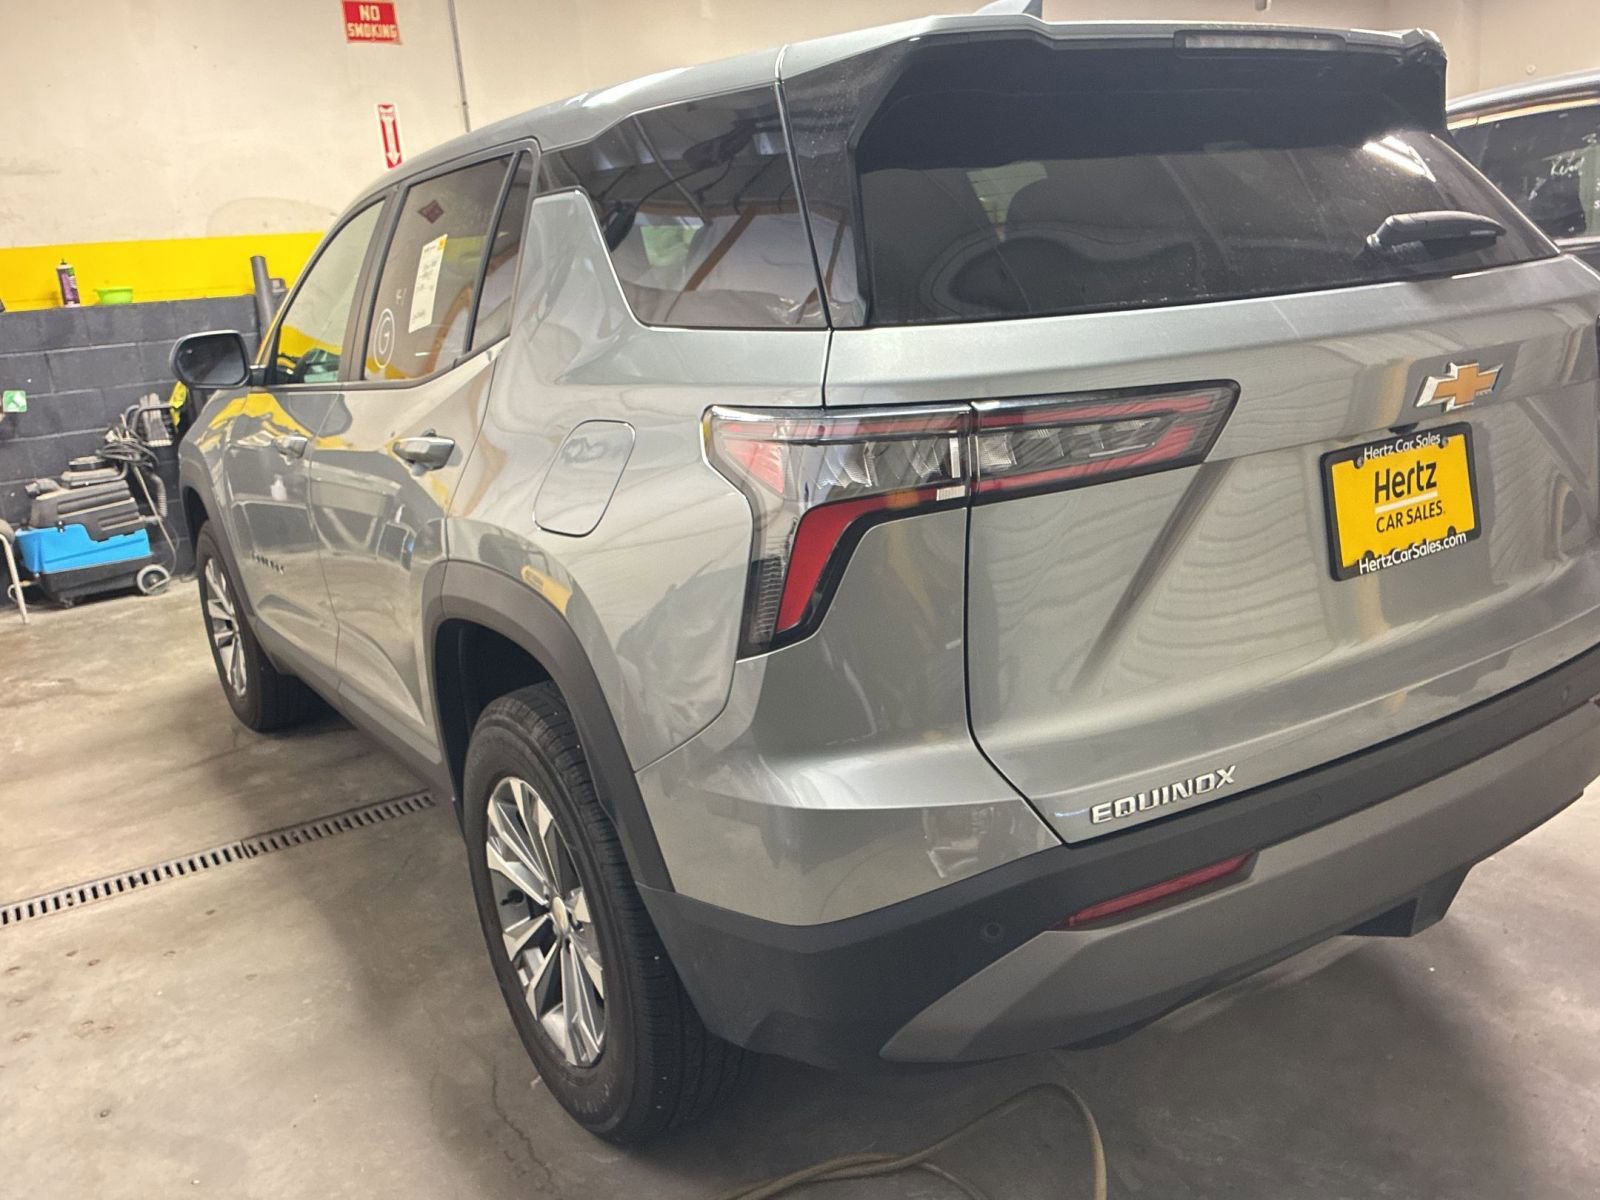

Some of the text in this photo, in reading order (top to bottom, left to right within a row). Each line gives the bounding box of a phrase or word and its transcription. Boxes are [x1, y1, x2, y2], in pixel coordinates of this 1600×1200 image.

[359, 4, 381, 21] NO
[347, 22, 398, 38] SMOKING
[1363, 432, 1441, 461] Hertz Car Sales
[1374, 460, 1437, 504] Hertz
[1376, 500, 1443, 533] CAR SALES
[1358, 532, 1467, 575] HertzCarSales.com
[1090, 765, 1236, 824] EQUINOX
